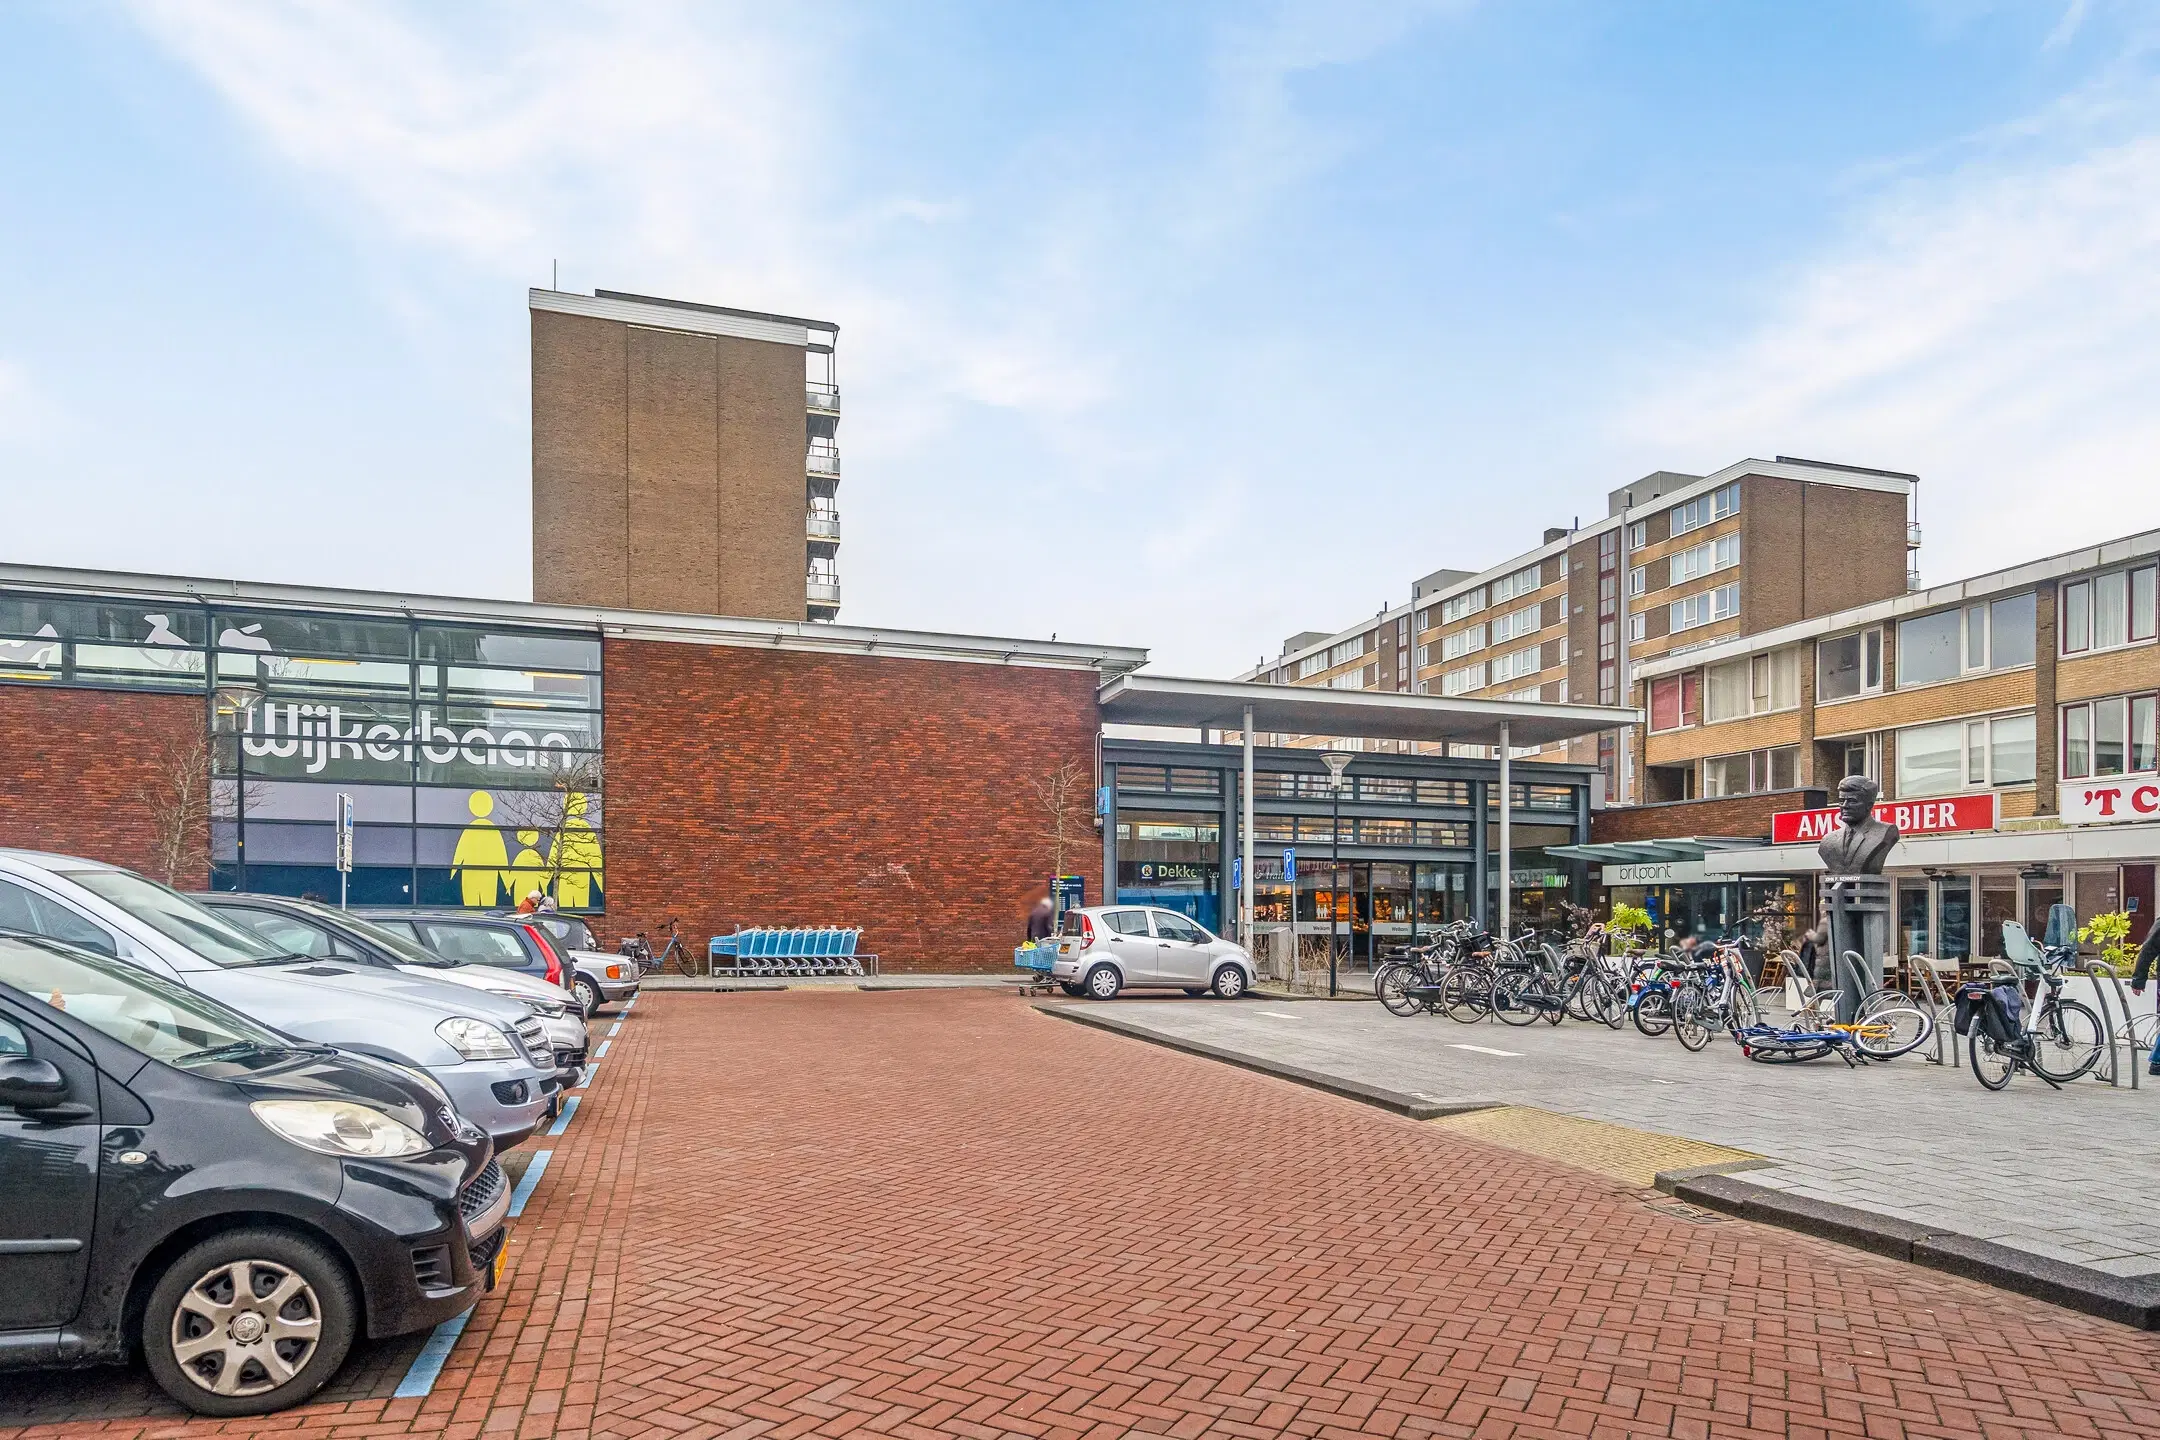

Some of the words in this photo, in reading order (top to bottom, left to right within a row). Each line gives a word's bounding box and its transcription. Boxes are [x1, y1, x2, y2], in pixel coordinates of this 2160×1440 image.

[241, 702, 572, 774] Wijkerbaan
[2131, 785, 2160, 813] C
[1894, 802, 1957, 831] BIER
[1158, 865, 1204, 878] Dekke
[1619, 862, 1672, 884] brilpoint
